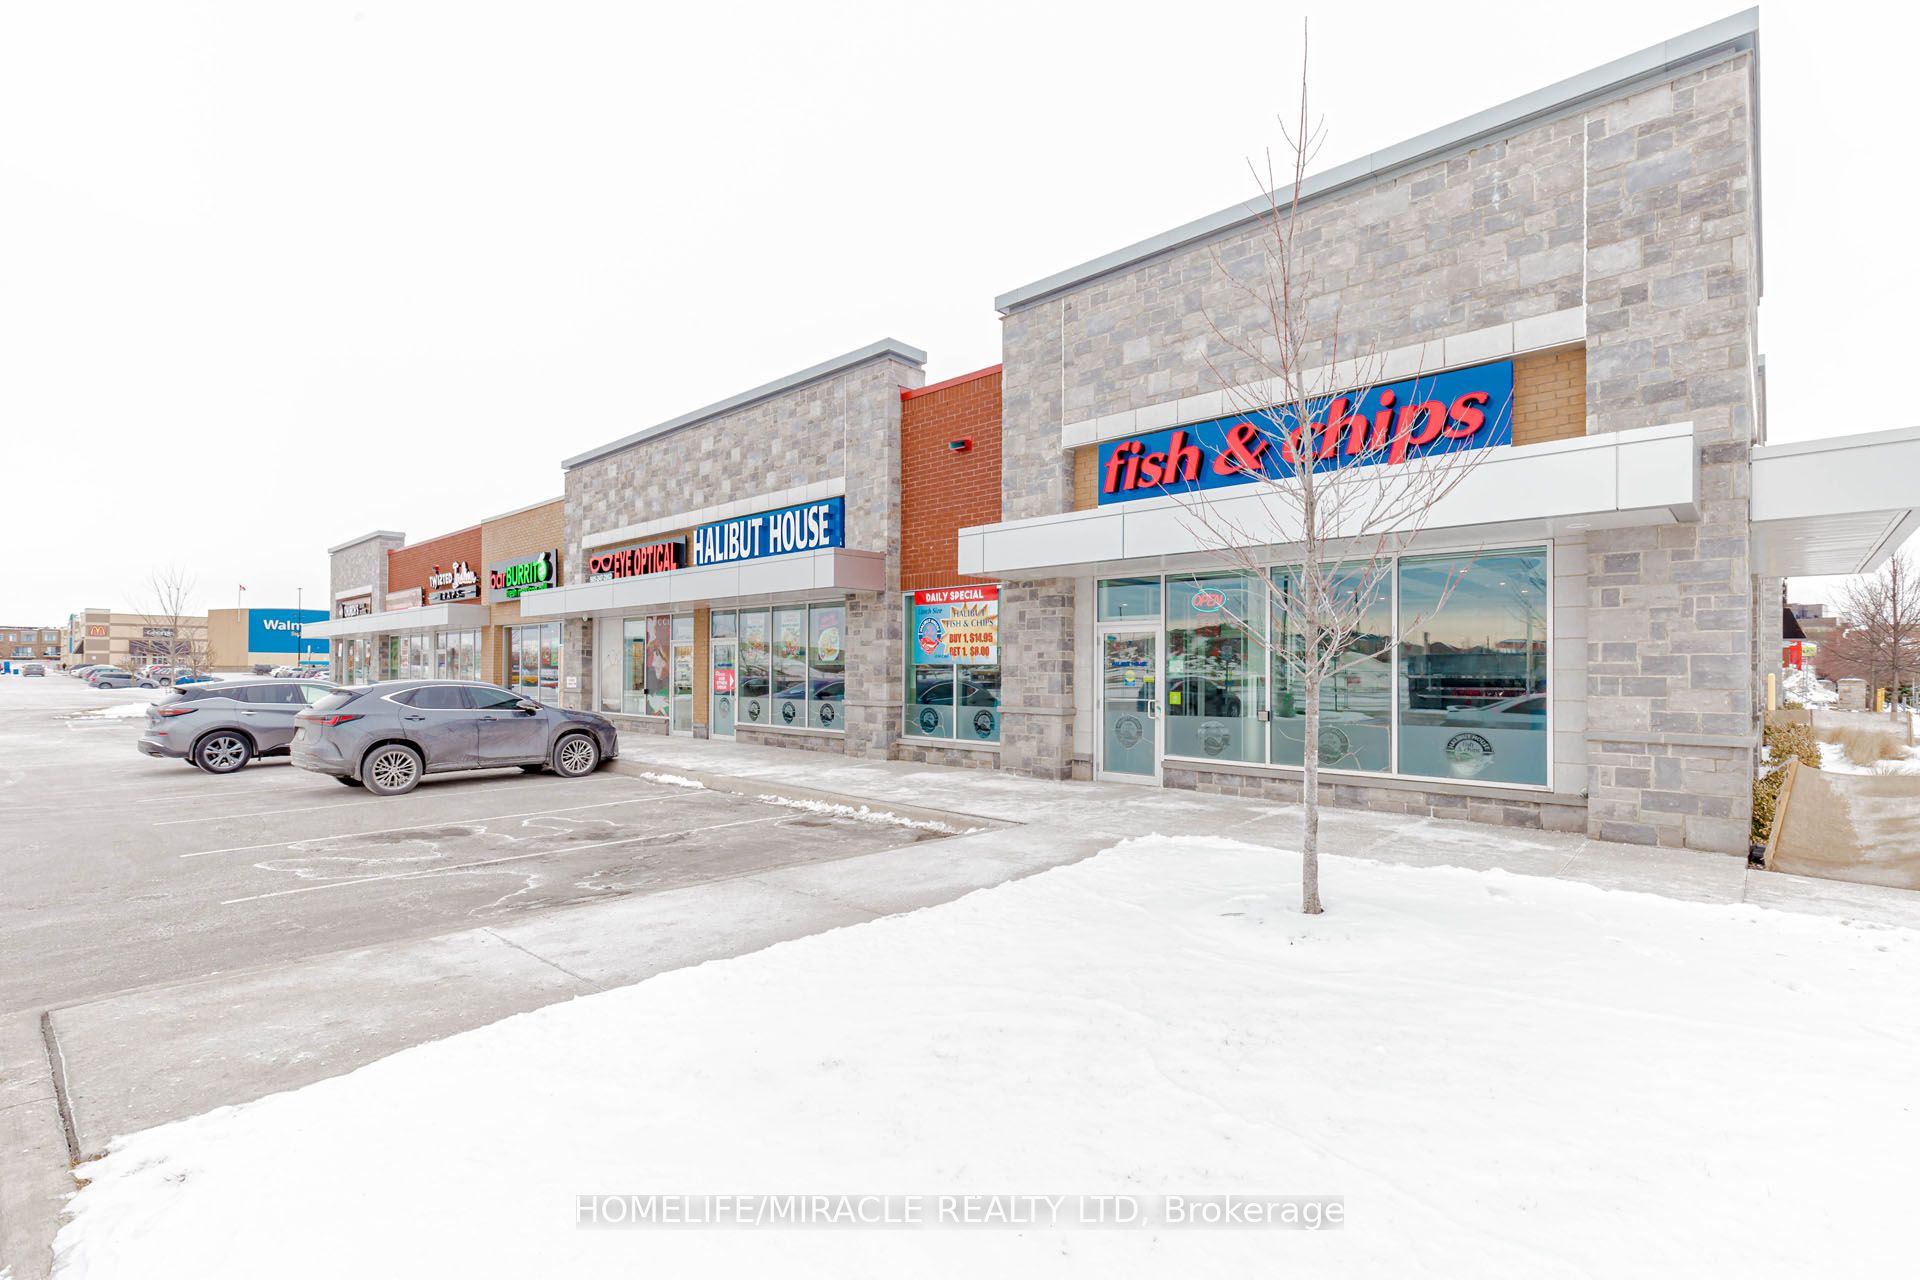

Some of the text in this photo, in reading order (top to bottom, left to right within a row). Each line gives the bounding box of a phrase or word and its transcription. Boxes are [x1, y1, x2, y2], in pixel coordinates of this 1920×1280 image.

[1103, 389, 1490, 494] fish & chips
[693, 504, 830, 565] HALIBUT HOUSE
[613, 542, 677, 579] EYE OPTICAL
[925, 589, 984, 602] DAILY SPECIAL
[1193, 594, 1223, 607] OPEN
[946, 617, 994, 627] FISH & CHIPS
[949, 633, 962, 643] BUY
